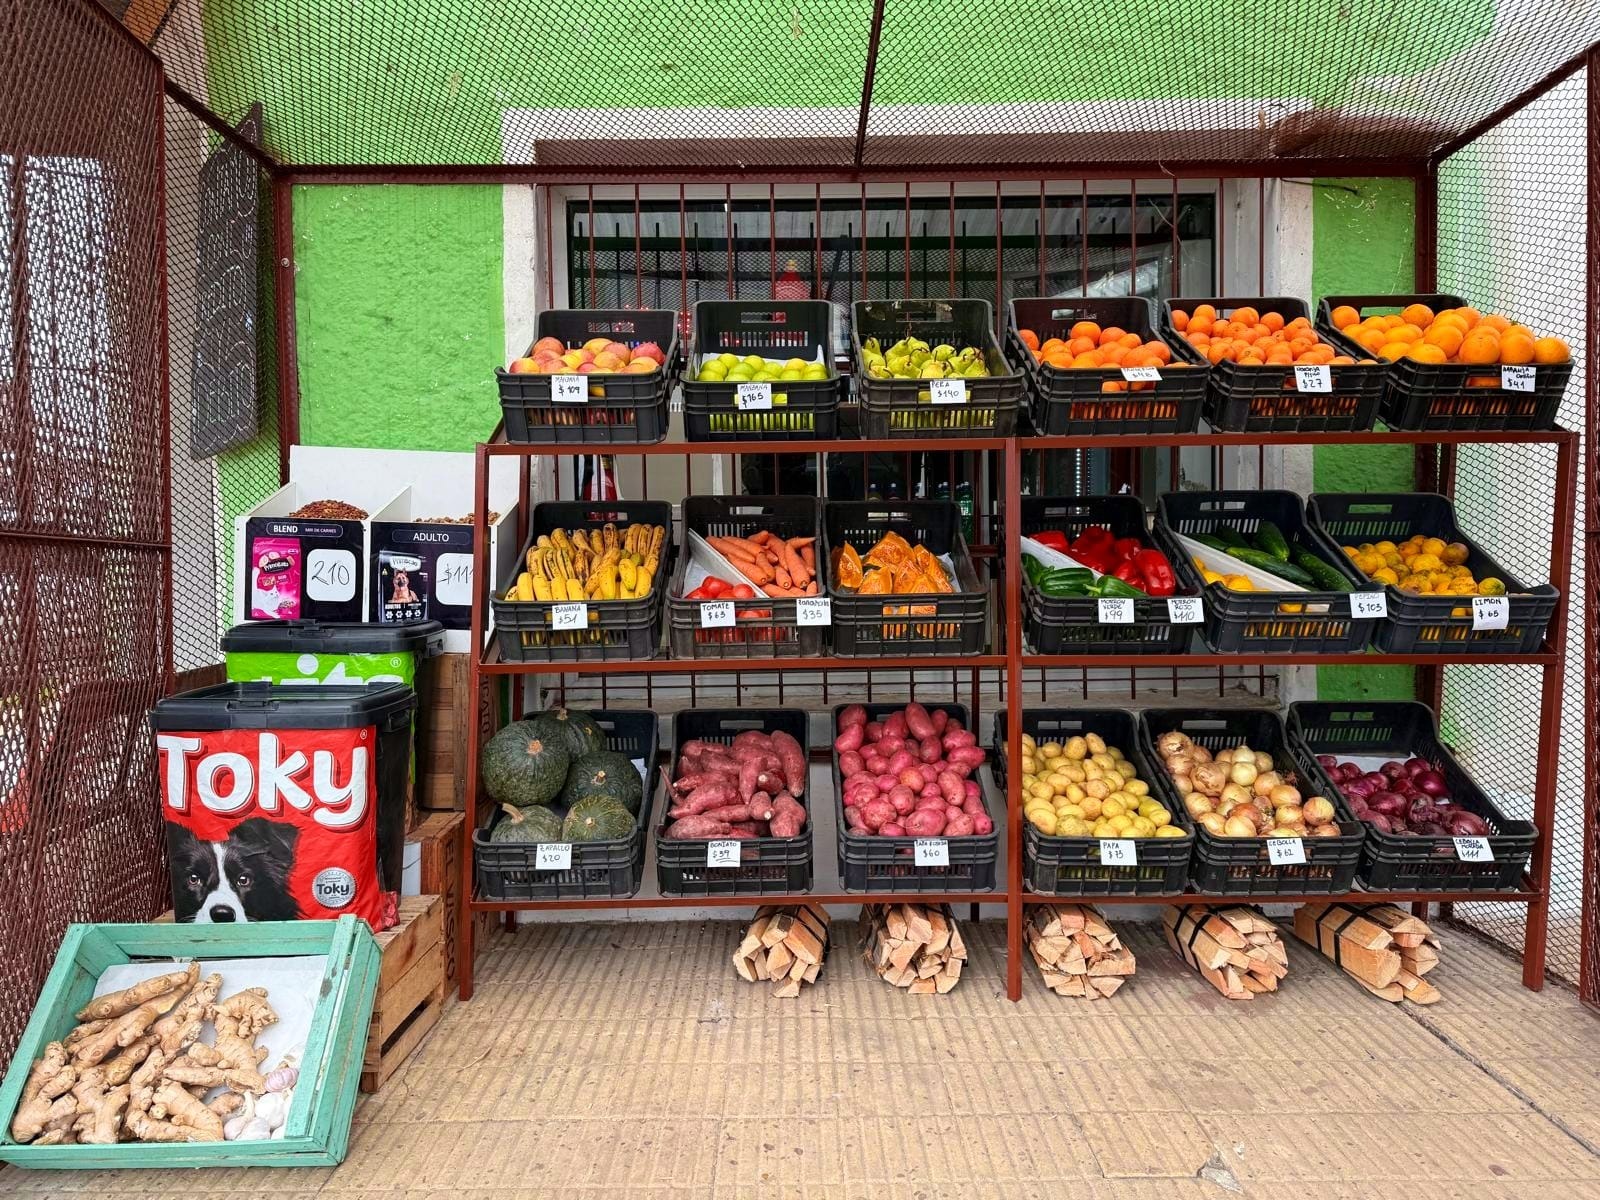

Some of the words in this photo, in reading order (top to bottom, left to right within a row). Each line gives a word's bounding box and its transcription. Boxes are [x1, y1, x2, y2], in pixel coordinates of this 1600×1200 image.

[273, 524, 299, 534] BLEND
[413, 531, 450, 543] ADULTO
[311, 560, 350, 586] 210
[702, 602, 730, 611] TOMATE
[1474, 598, 1502, 606] LIMON
[554, 605, 581, 614] BANANA
[802, 608, 823, 620] $35
[1104, 610, 1123, 621] $99
[156, 731, 370, 828] Toky
[1103, 841, 1120, 849] PAPA
[542, 854, 561, 863] $20
[923, 849, 940, 858] $60
[316, 883, 350, 896] Toky
